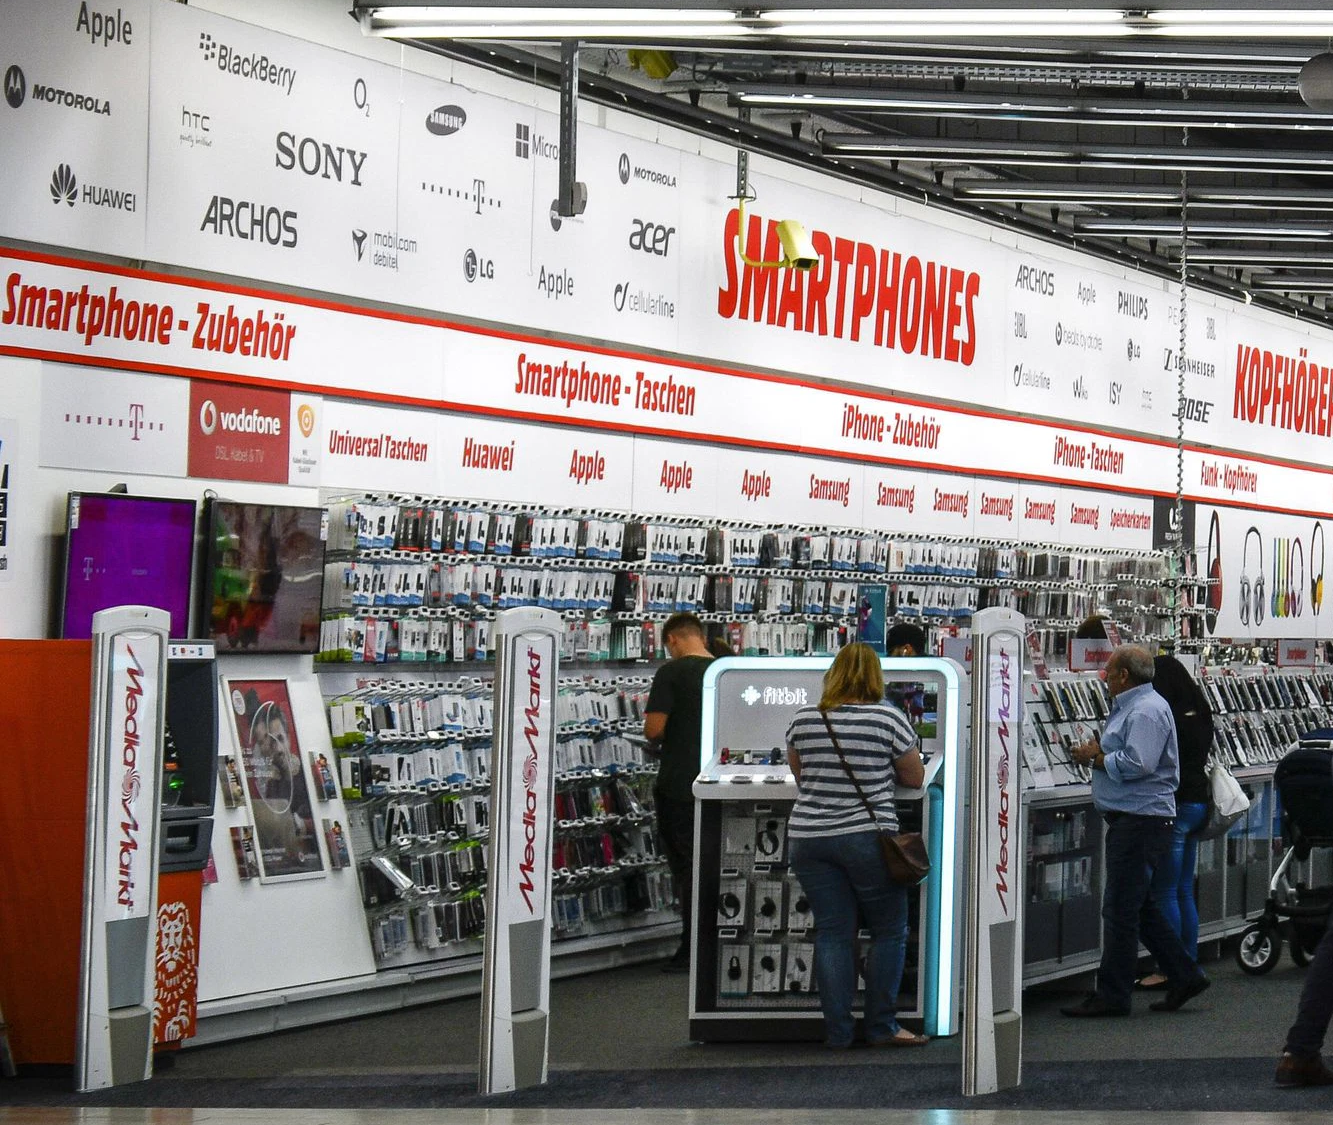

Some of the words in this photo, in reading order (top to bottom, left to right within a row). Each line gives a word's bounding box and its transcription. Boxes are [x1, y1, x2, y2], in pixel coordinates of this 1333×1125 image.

[76, 1, 132, 47] Apple
[218, 44, 296, 96] BlackBerry
[32, 83, 111, 116] MOTOROLA
[430, 107, 463, 131] SAMSUNG
[275, 131, 368, 187] SONY
[634, 166, 677, 188] MOTOROLA
[82, 184, 136, 213] HUAWEI
[200, 195, 298, 249] ARCHOS
[629, 218, 676, 257] acer
[373, 229, 417, 254] mobilcom
[480, 257, 494, 279] LG
[538, 265, 574, 300] Apple
[1015, 264, 1055, 296] ARCHOS
[718, 207, 981, 367] SMARTPHONES
[1078, 281, 1096, 305] Apple
[2, 272, 172, 346] Smartphone
[192, 301, 297, 362] Zubehör
[628, 289, 675, 319] cellularline
[1118, 290, 1148, 320] PHILIPS
[515, 353, 622, 408] Smartphone
[635, 372, 696, 416] Taschen
[1109, 381, 1122, 405] ISY
[220, 409, 281, 436] vodafone
[842, 403, 883, 443] iPhone
[893, 412, 941, 450] Zubehör
[328, 429, 384, 459] Universal
[384, 433, 427, 463] Taschen
[462, 437, 515, 472] Huawei
[1053, 434, 1086, 469] iPhone
[569, 449, 605, 482] Apple
[660, 459, 692, 494] Apple
[1201, 460, 1219, 487] Funk
[1223, 463, 1258, 495] Kopfhörer
[741, 469, 771, 501] Apple
[809, 473, 850, 508] Samsung
[876, 481, 915, 514] Samsung
[933, 487, 968, 518] Samsung
[980, 491, 1014, 521] Samsung
[1024, 497, 1056, 526] Samsung
[1070, 502, 1100, 531] Samsung
[1110, 508, 1151, 532] Speicherkarten
[763, 685, 807, 705] fitbit
